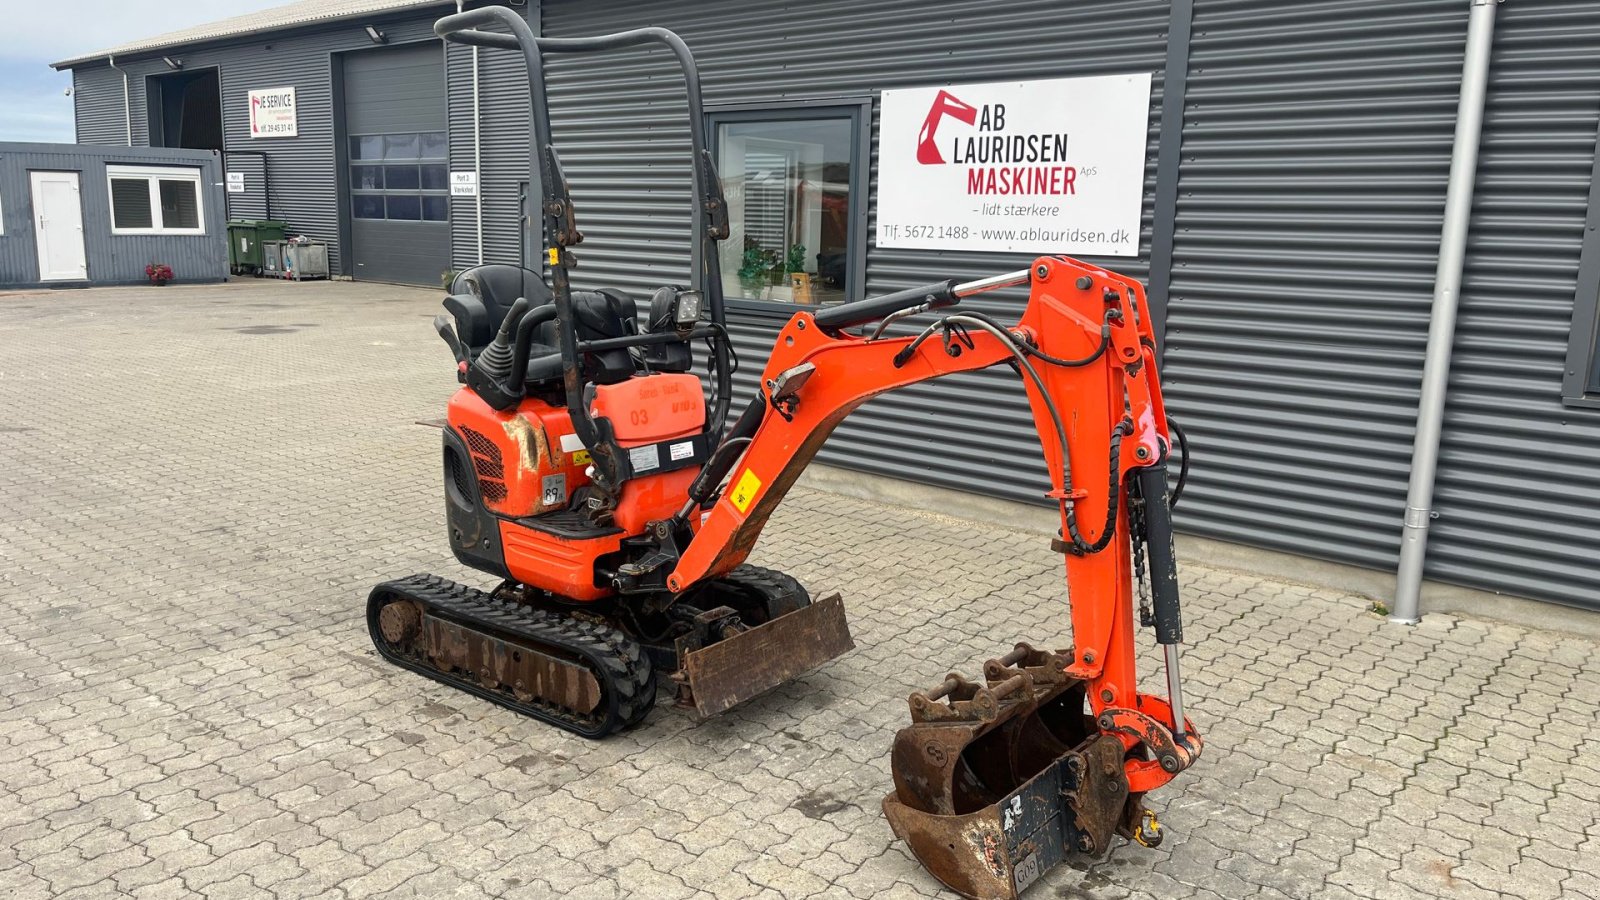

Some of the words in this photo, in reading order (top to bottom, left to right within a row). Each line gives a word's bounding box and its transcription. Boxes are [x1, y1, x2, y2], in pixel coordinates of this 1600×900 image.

[260, 96, 266, 108] JE
[267, 94, 291, 107] SERVICE
[979, 104, 1006, 132] AB
[954, 134, 1068, 164] LAURIDSEN
[968, 166, 1076, 195] MASKINER
[1080, 166, 1097, 176] ApS
[982, 203, 1001, 216] lidt
[1004, 204, 1060, 216] stærkere
[883, 225, 901, 240] Tlf.
[905, 226, 934, 239] 5672
[938, 226, 969, 239] 1488
[981, 228, 1130, 244] www.ablauridsen.dk
[630, 409, 648, 426] 03
[546, 488, 558, 502] 89
[1017, 860, 1036, 884] G09
